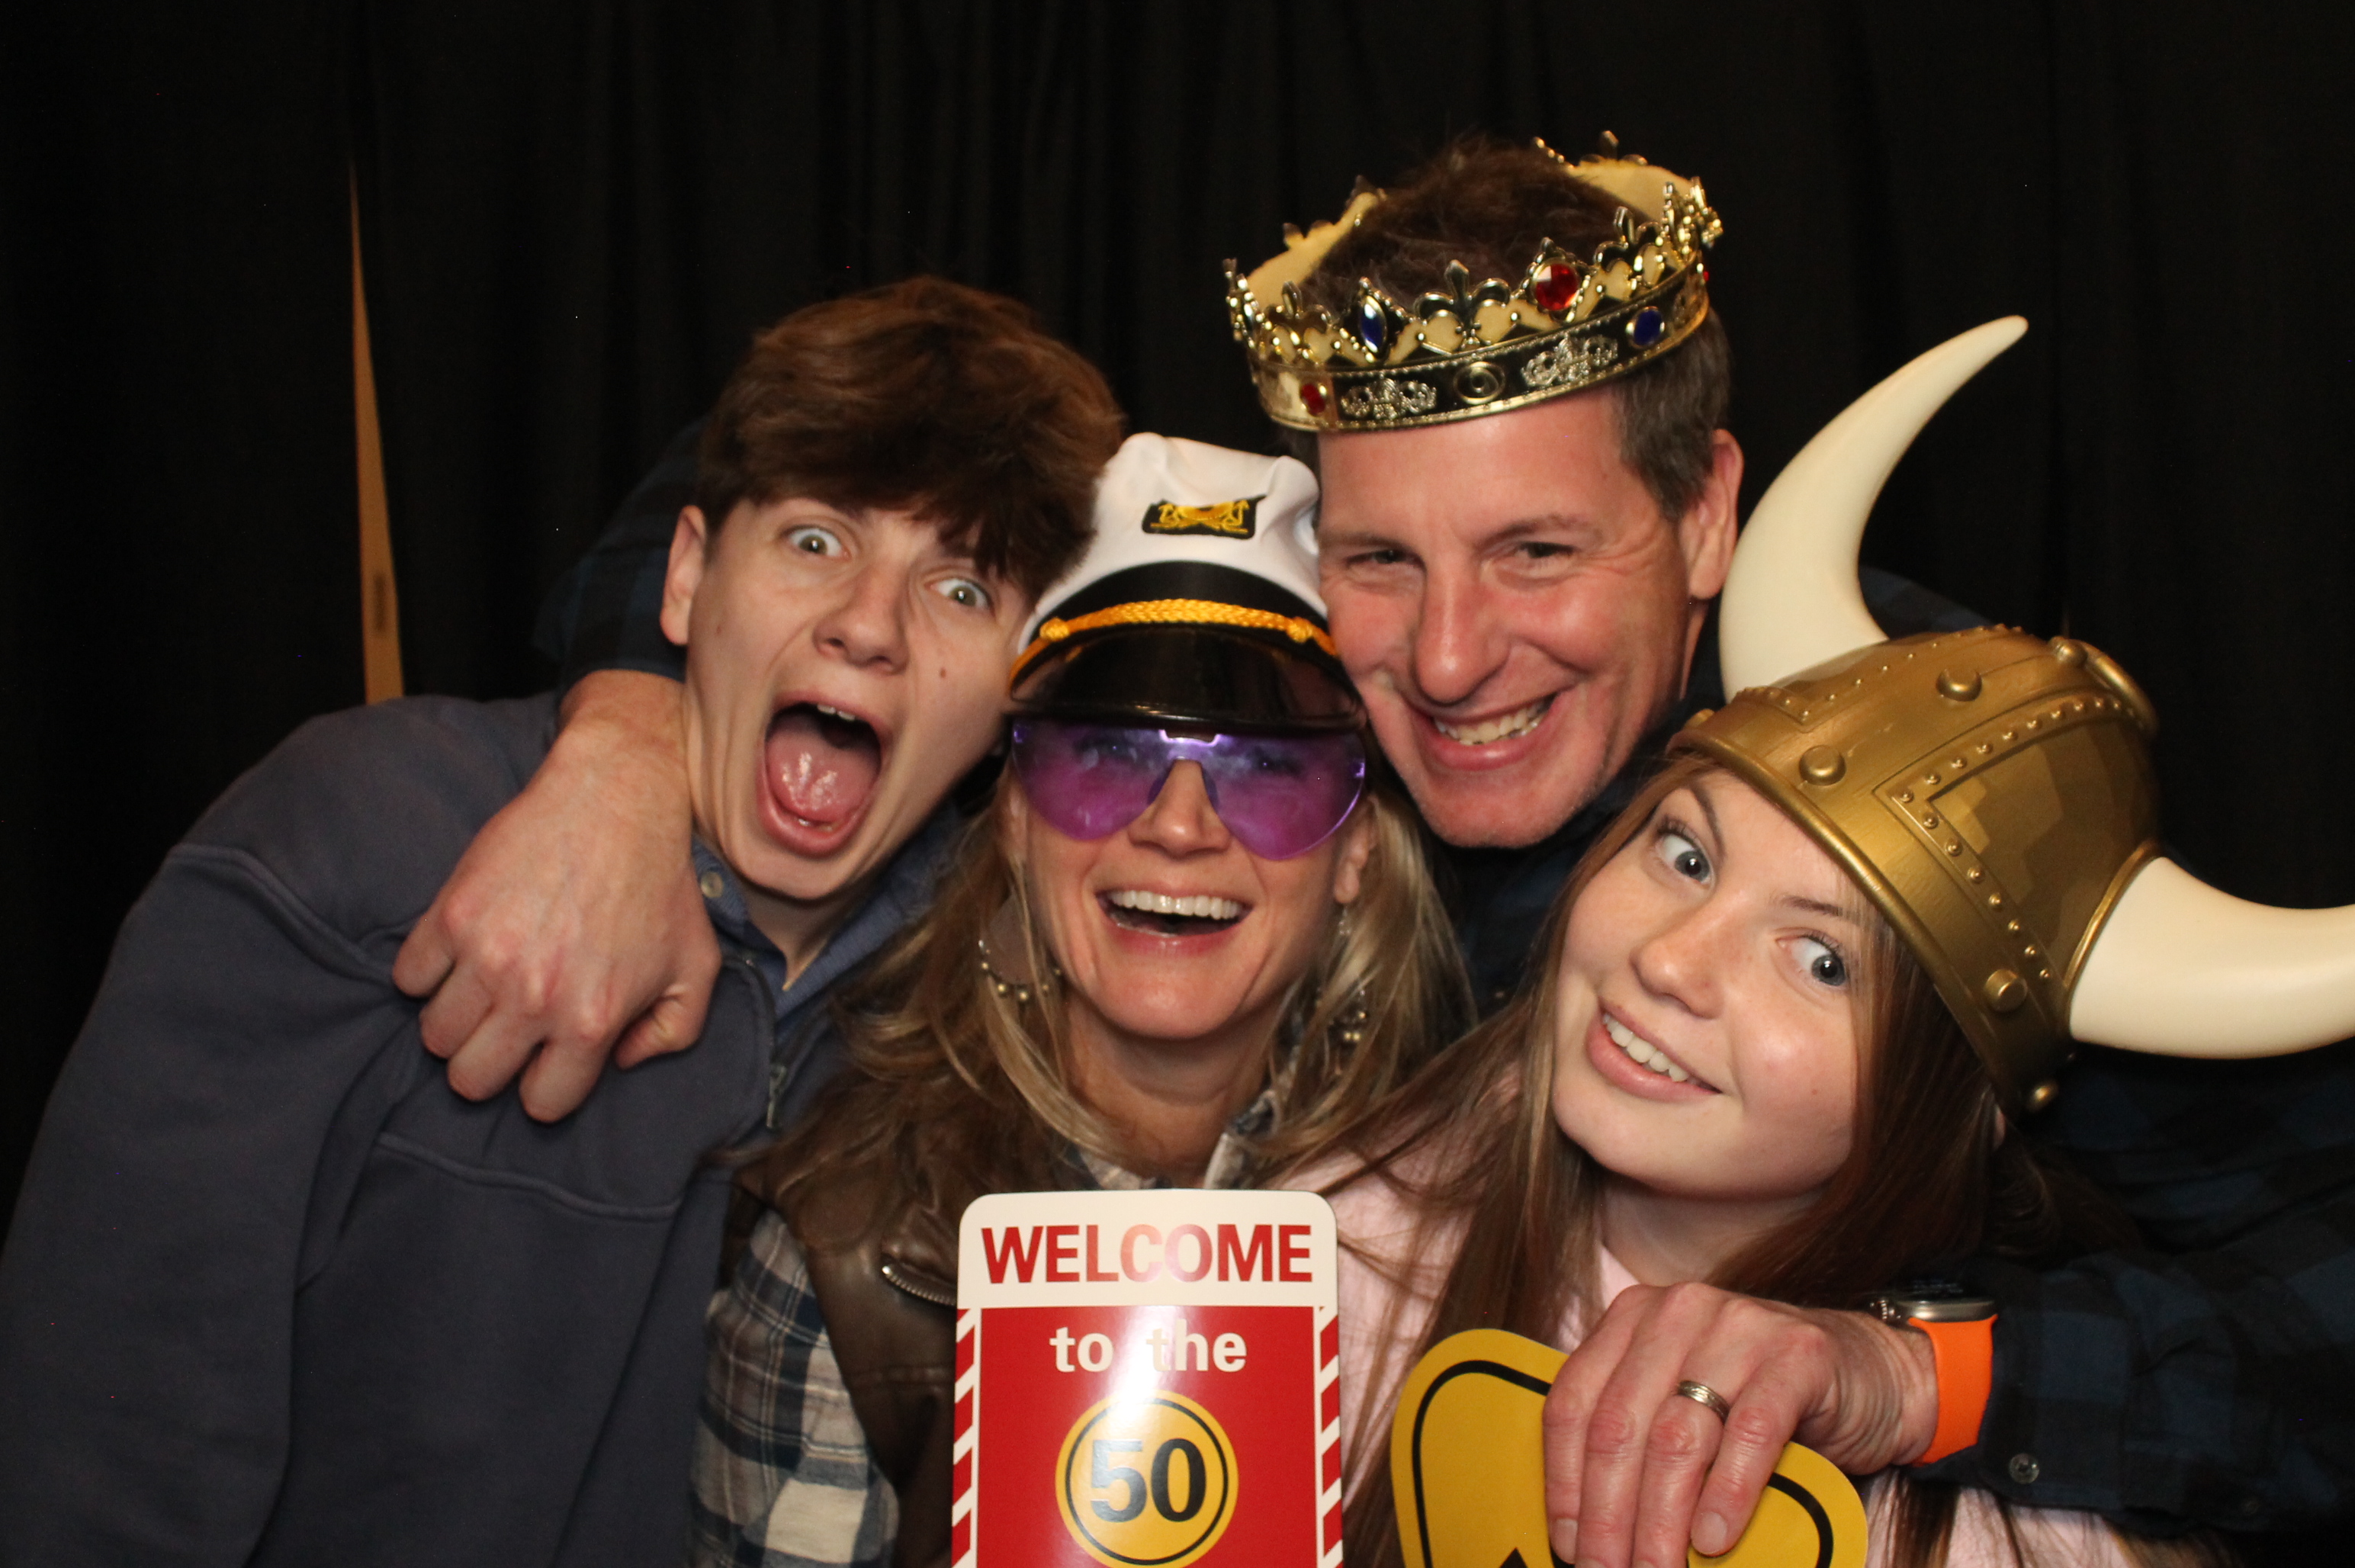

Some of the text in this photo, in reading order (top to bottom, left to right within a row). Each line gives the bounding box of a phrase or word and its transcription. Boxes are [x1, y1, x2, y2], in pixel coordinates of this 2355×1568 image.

[981, 1224, 1312, 1284] WELCOME
[1049, 1319, 1247, 1372] to the
[1090, 1438, 1206, 1522] 50
